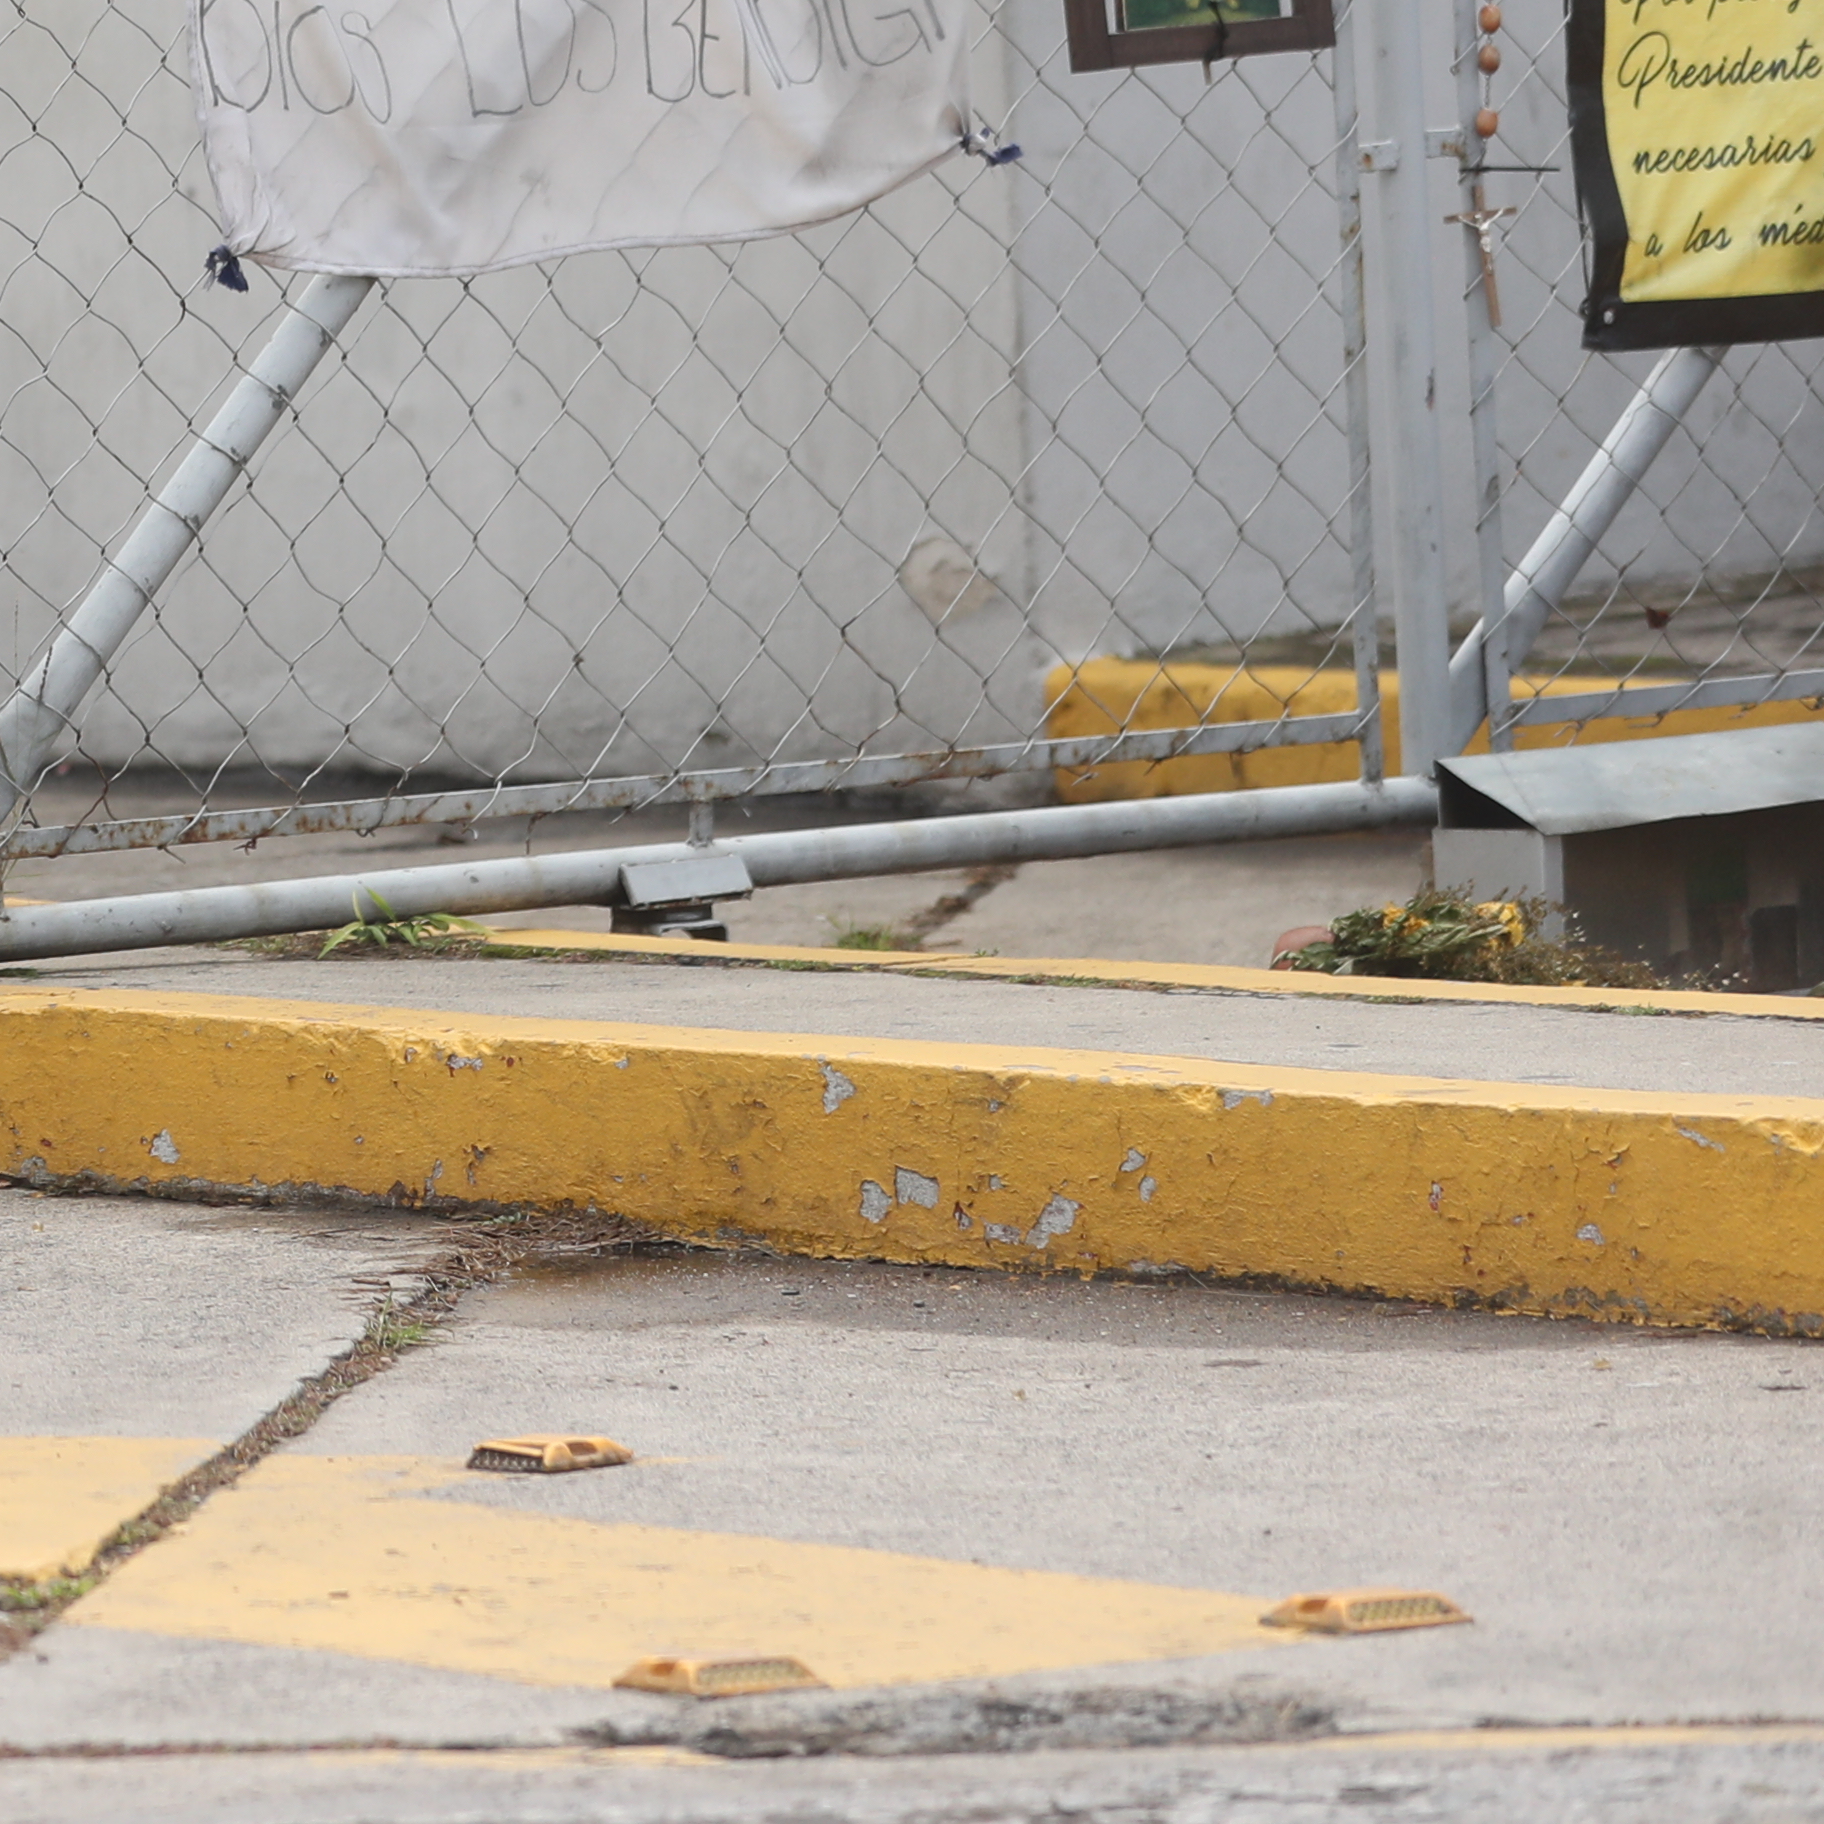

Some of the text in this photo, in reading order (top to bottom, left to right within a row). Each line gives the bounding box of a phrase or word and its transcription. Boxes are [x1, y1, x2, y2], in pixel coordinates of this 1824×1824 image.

[1618, 31, 1821, 109] Presidente
[1633, 136, 1815, 174] necesarias
[1644, 232, 1663, 258] a
[1683, 211, 1731, 254] los
